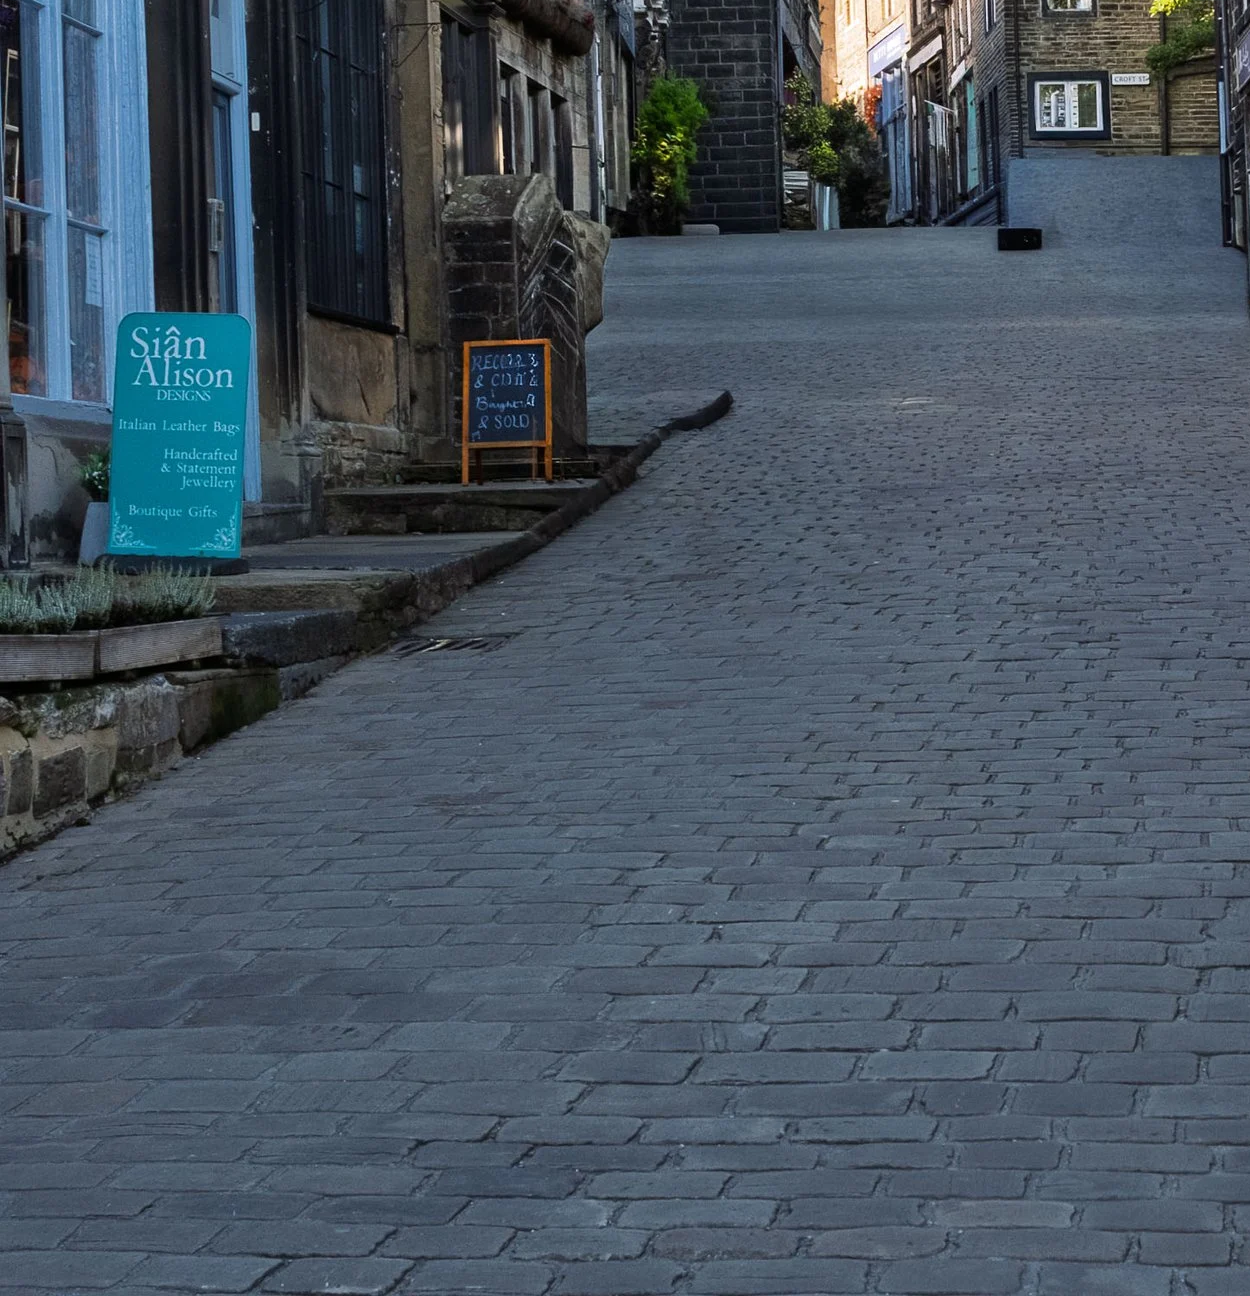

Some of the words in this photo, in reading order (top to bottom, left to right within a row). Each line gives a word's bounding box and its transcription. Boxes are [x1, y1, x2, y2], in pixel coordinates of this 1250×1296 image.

[1114, 75, 1136, 83] CROFT
[130, 325, 207, 360] Siân
[131, 355, 234, 388] Alison
[156, 389, 211, 402] DESIGNS
[119, 418, 157, 431] Italian
[162, 419, 207, 432] Leather
[213, 420, 240, 437] Bags
[478, 415, 490, 429] &
[494, 413, 530, 429] SOLD
[164, 448, 238, 461] Handcrafted
[160, 463, 171, 473] &
[176, 462, 236, 475] Statement
[180, 475, 236, 492] Jewellery
[128, 504, 183, 520] Boutique
[188, 505, 218, 518] Gifts
